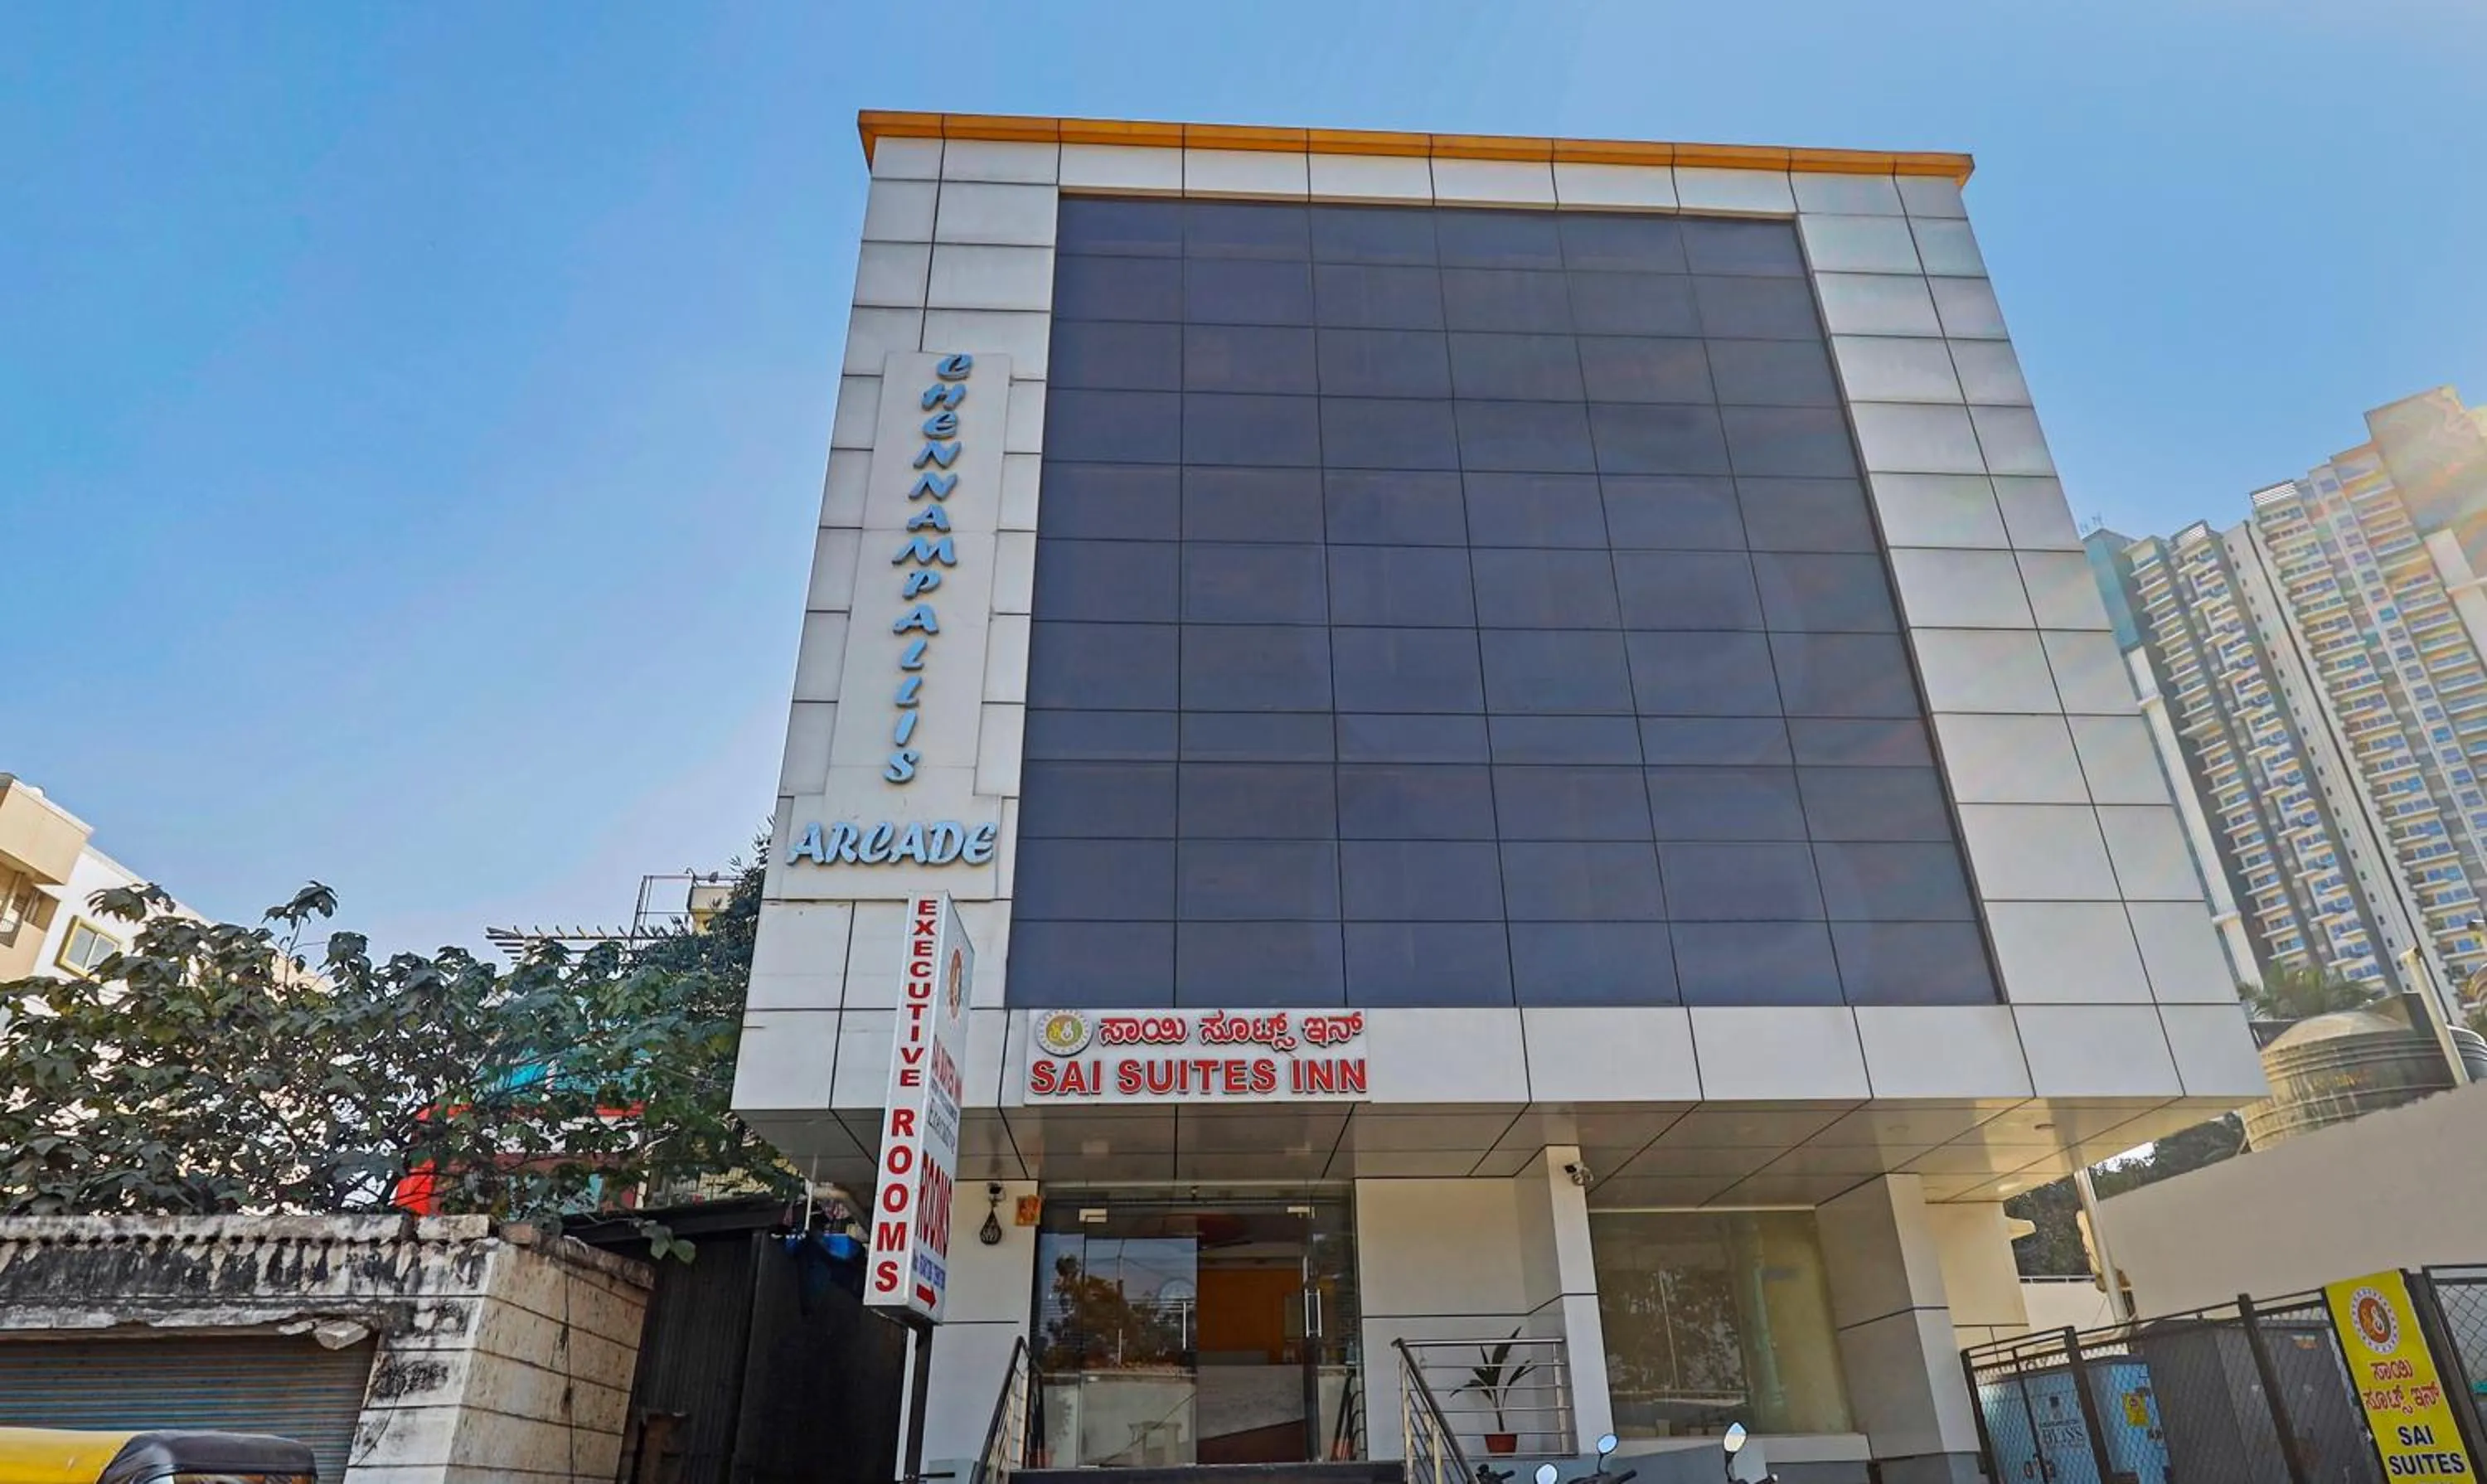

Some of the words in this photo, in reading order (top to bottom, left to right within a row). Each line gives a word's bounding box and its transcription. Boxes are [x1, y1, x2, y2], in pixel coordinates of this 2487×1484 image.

[883, 353, 972, 784] CHENNAMPALLIS
[786, 819, 996, 867] ARCADE
[899, 900, 937, 1087] EXECUTIVE
[1099, 1016, 1187, 1044] ಸಾಯಿ
[1303, 1011, 1365, 1045] ಇನ್
[1031, 1060, 1101, 1094] SAI
[1117, 1059, 1277, 1094] SUITES
[1292, 1060, 1367, 1094] INN
[874, 1108, 915, 1292] ROOMS
[2397, 1425, 2433, 1445] SAI
[2388, 1452, 2465, 1475] SUITES
